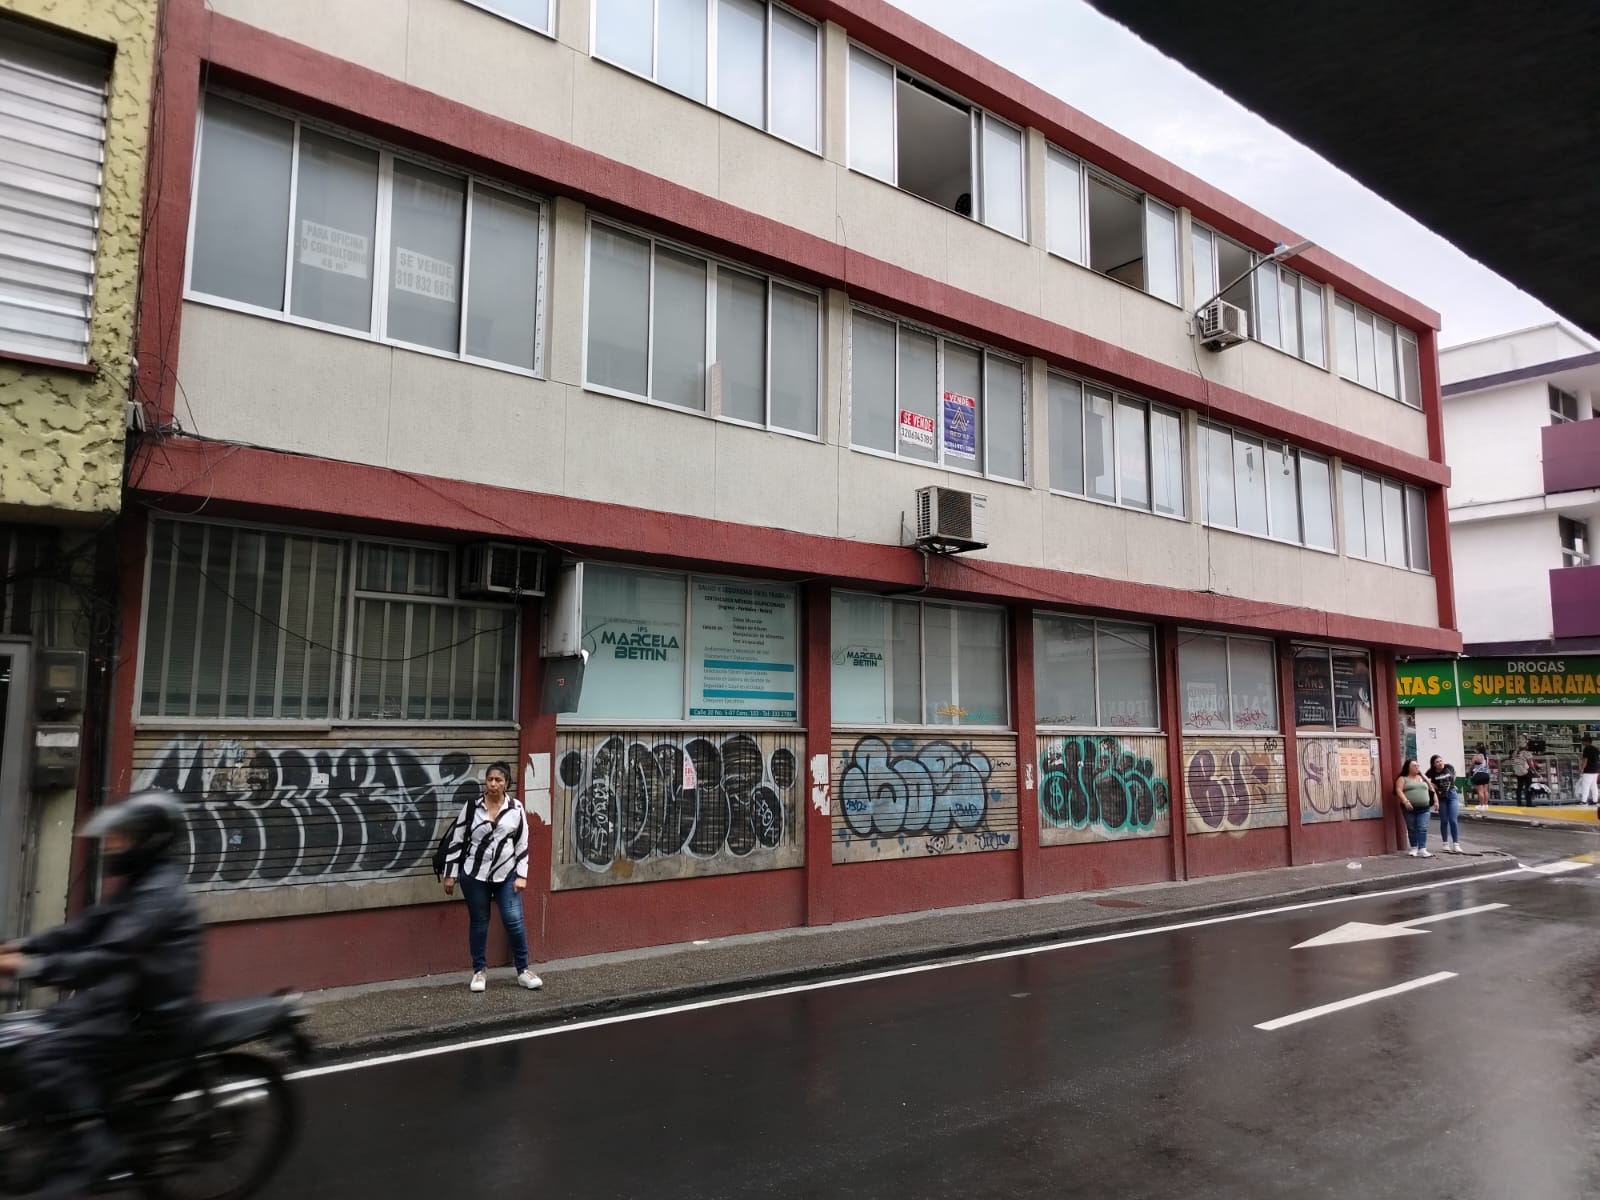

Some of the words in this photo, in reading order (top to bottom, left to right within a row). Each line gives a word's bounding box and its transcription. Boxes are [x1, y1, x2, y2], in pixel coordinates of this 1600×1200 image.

[400, 252, 414, 268] SE
[417, 257, 453, 280] VENDE
[903, 411, 912, 425] SE
[913, 415, 933, 432] VENDE
[601, 630, 680, 649] MARCELA
[614, 645, 667, 662] BETTIN
[846, 650, 883, 661] MARCELA
[1507, 661, 1566, 673] DROGAS
[1472, 675, 1526, 696] SUPER
